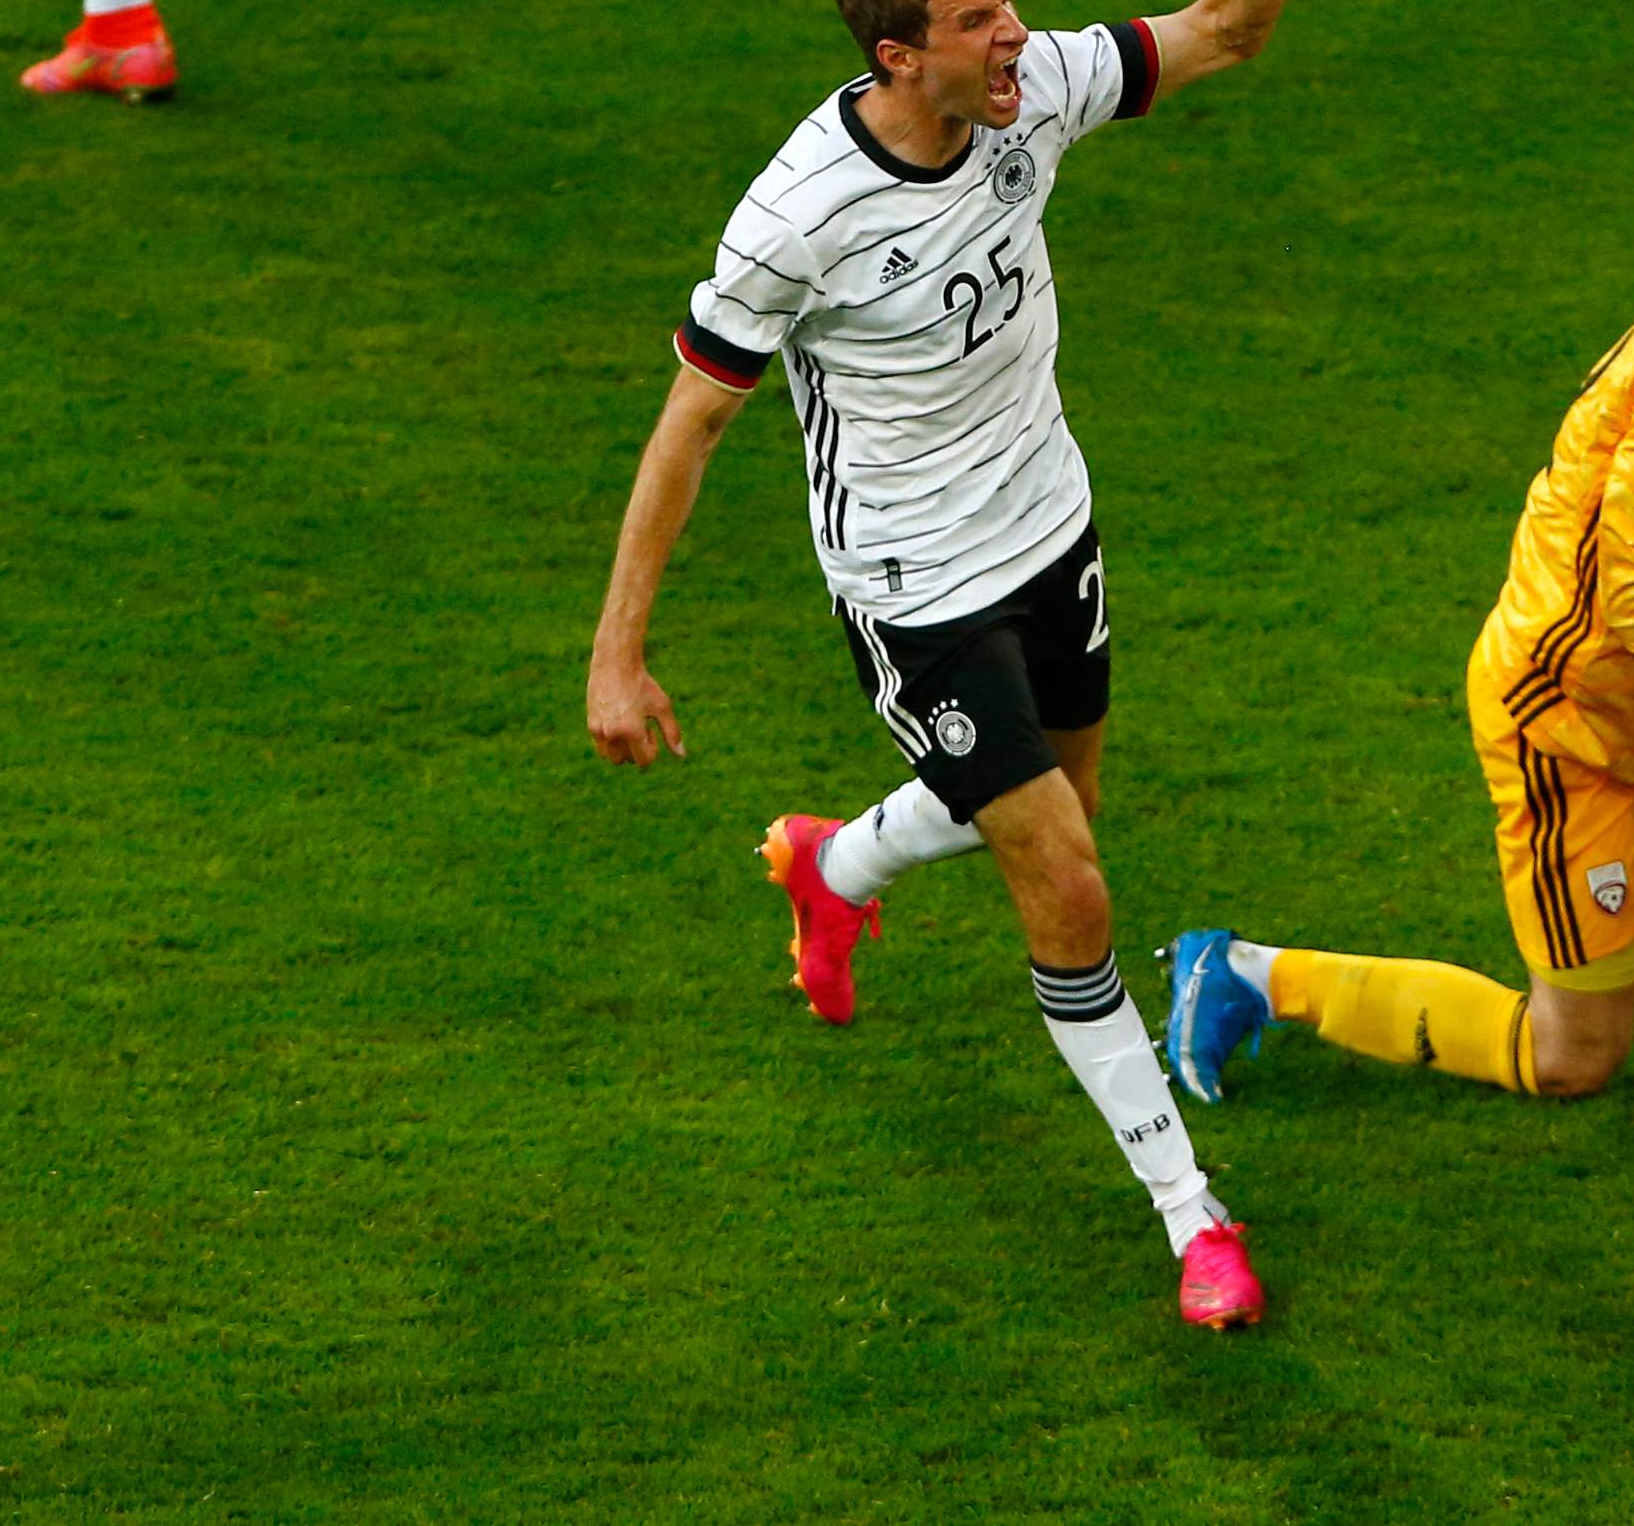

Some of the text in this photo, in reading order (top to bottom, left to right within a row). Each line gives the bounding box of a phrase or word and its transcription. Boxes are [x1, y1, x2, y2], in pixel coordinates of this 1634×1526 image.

[879, 258, 919, 285] adidas
[943, 234, 1024, 359] 25
[1119, 1113, 1170, 1143] DFB
